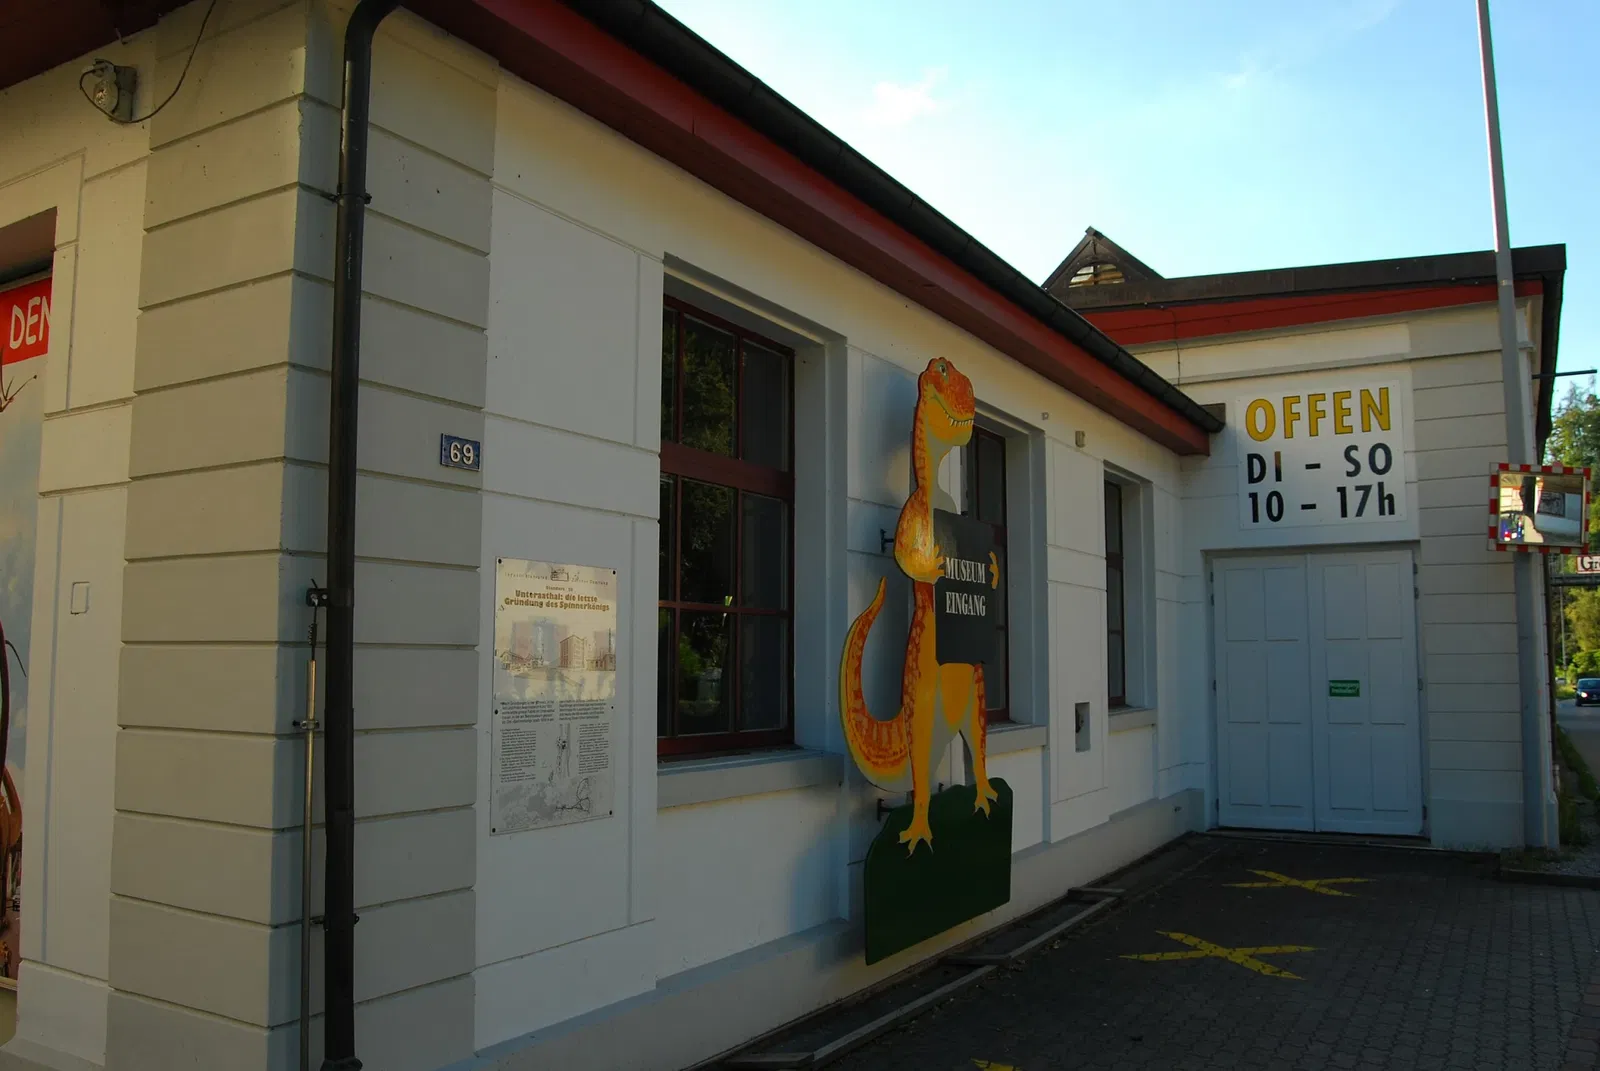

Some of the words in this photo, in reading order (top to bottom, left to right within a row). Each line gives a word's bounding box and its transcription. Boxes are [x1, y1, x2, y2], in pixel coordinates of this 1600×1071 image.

[1245, 387, 1391, 442] OFFEN
[450, 441, 474, 465] 69
[1247, 451, 1282, 484] DI
[1344, 442, 1393, 477] SO
[1248, 490, 1284, 523] 10
[1336, 481, 1396, 518] 17h
[945, 557, 986, 584] MUSEUM
[1580, 555, 1600, 571] Gr
[504, 597, 544, 608] Gründung
[545, 600, 558, 608] des
[565, 593, 576, 602] die
[577, 594, 598, 603] letzte
[945, 591, 986, 617] EINGANG
